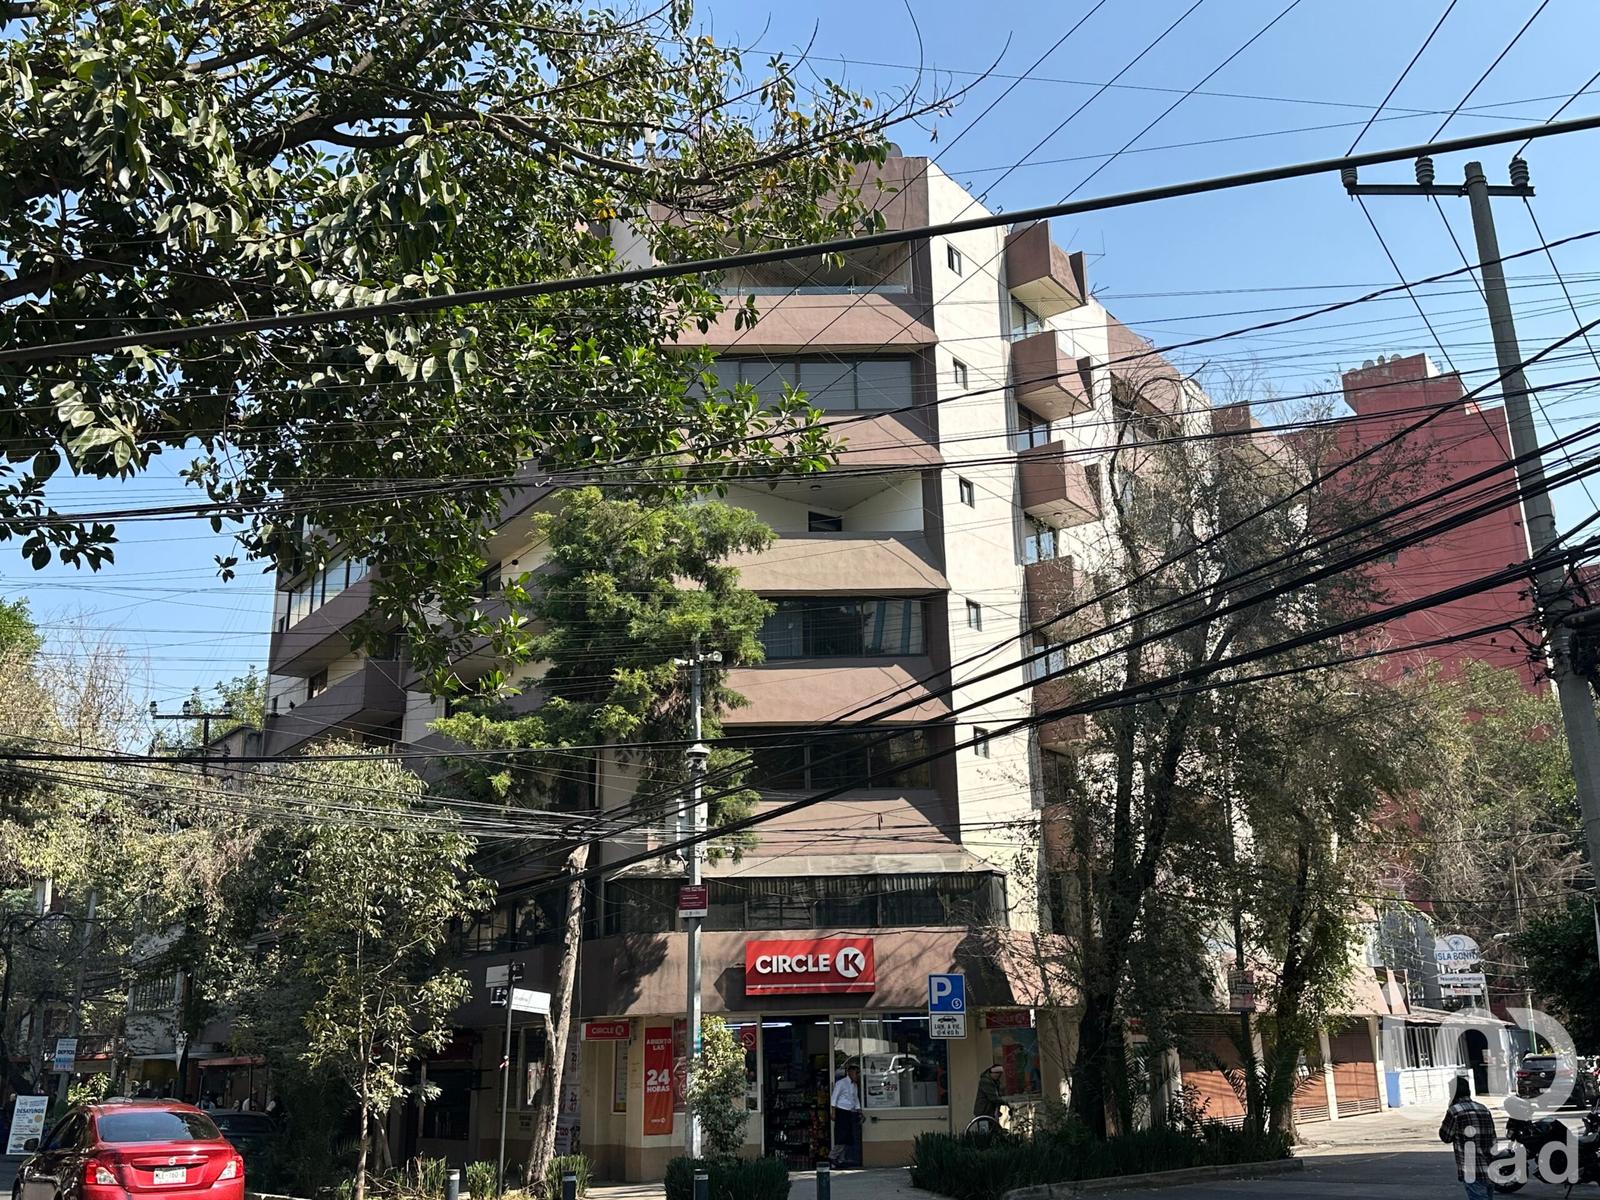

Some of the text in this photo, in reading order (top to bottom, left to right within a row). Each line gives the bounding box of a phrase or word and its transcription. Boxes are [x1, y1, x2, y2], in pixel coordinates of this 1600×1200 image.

[755, 953, 831, 974] CIRCLE
[1435, 952, 1452, 960] ISLA
[930, 977, 952, 1005] P
[647, 1069, 670, 1086] 24
